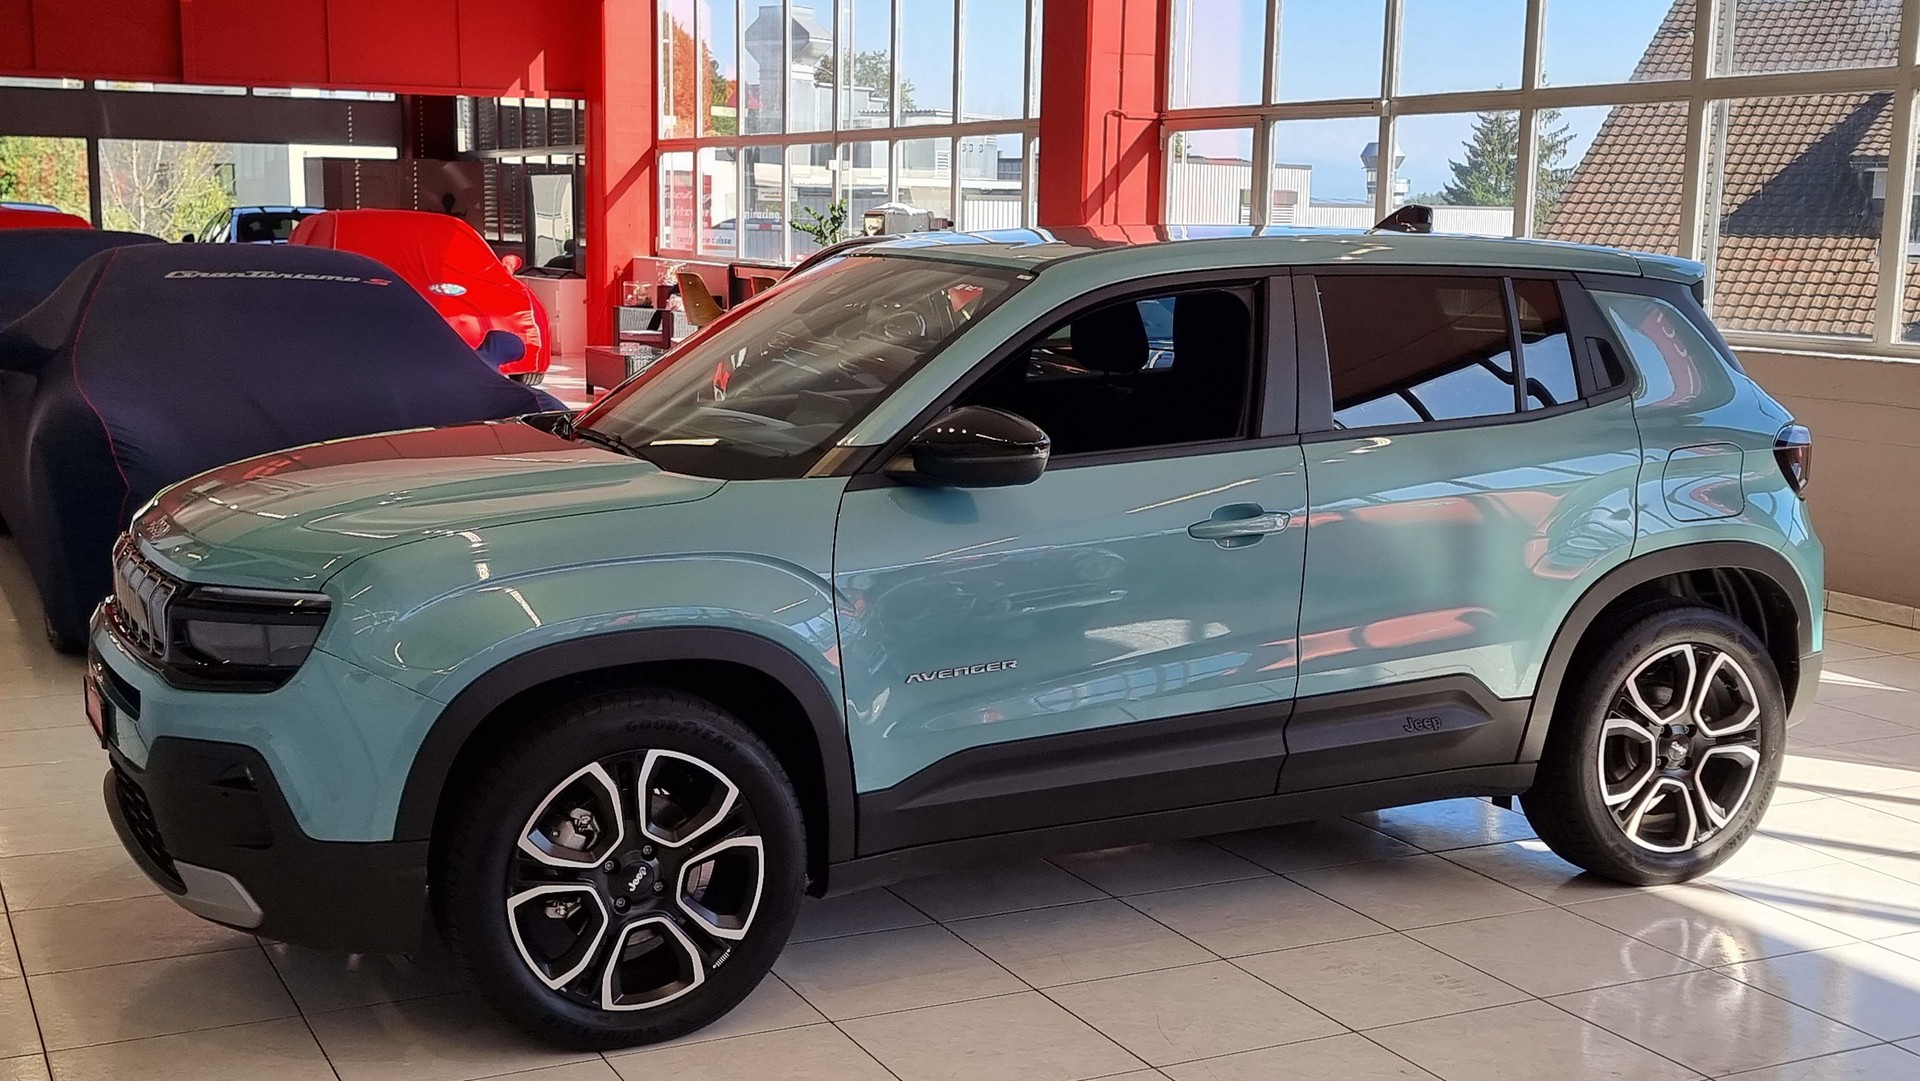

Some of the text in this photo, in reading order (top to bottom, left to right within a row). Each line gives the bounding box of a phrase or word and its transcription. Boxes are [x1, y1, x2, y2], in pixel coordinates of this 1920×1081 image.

[164, 270, 361, 282] GranTurismo
[905, 659, 1018, 684] AVENGER
[1403, 716, 1442, 732] Jeep
[628, 866, 647, 891] Jeep
